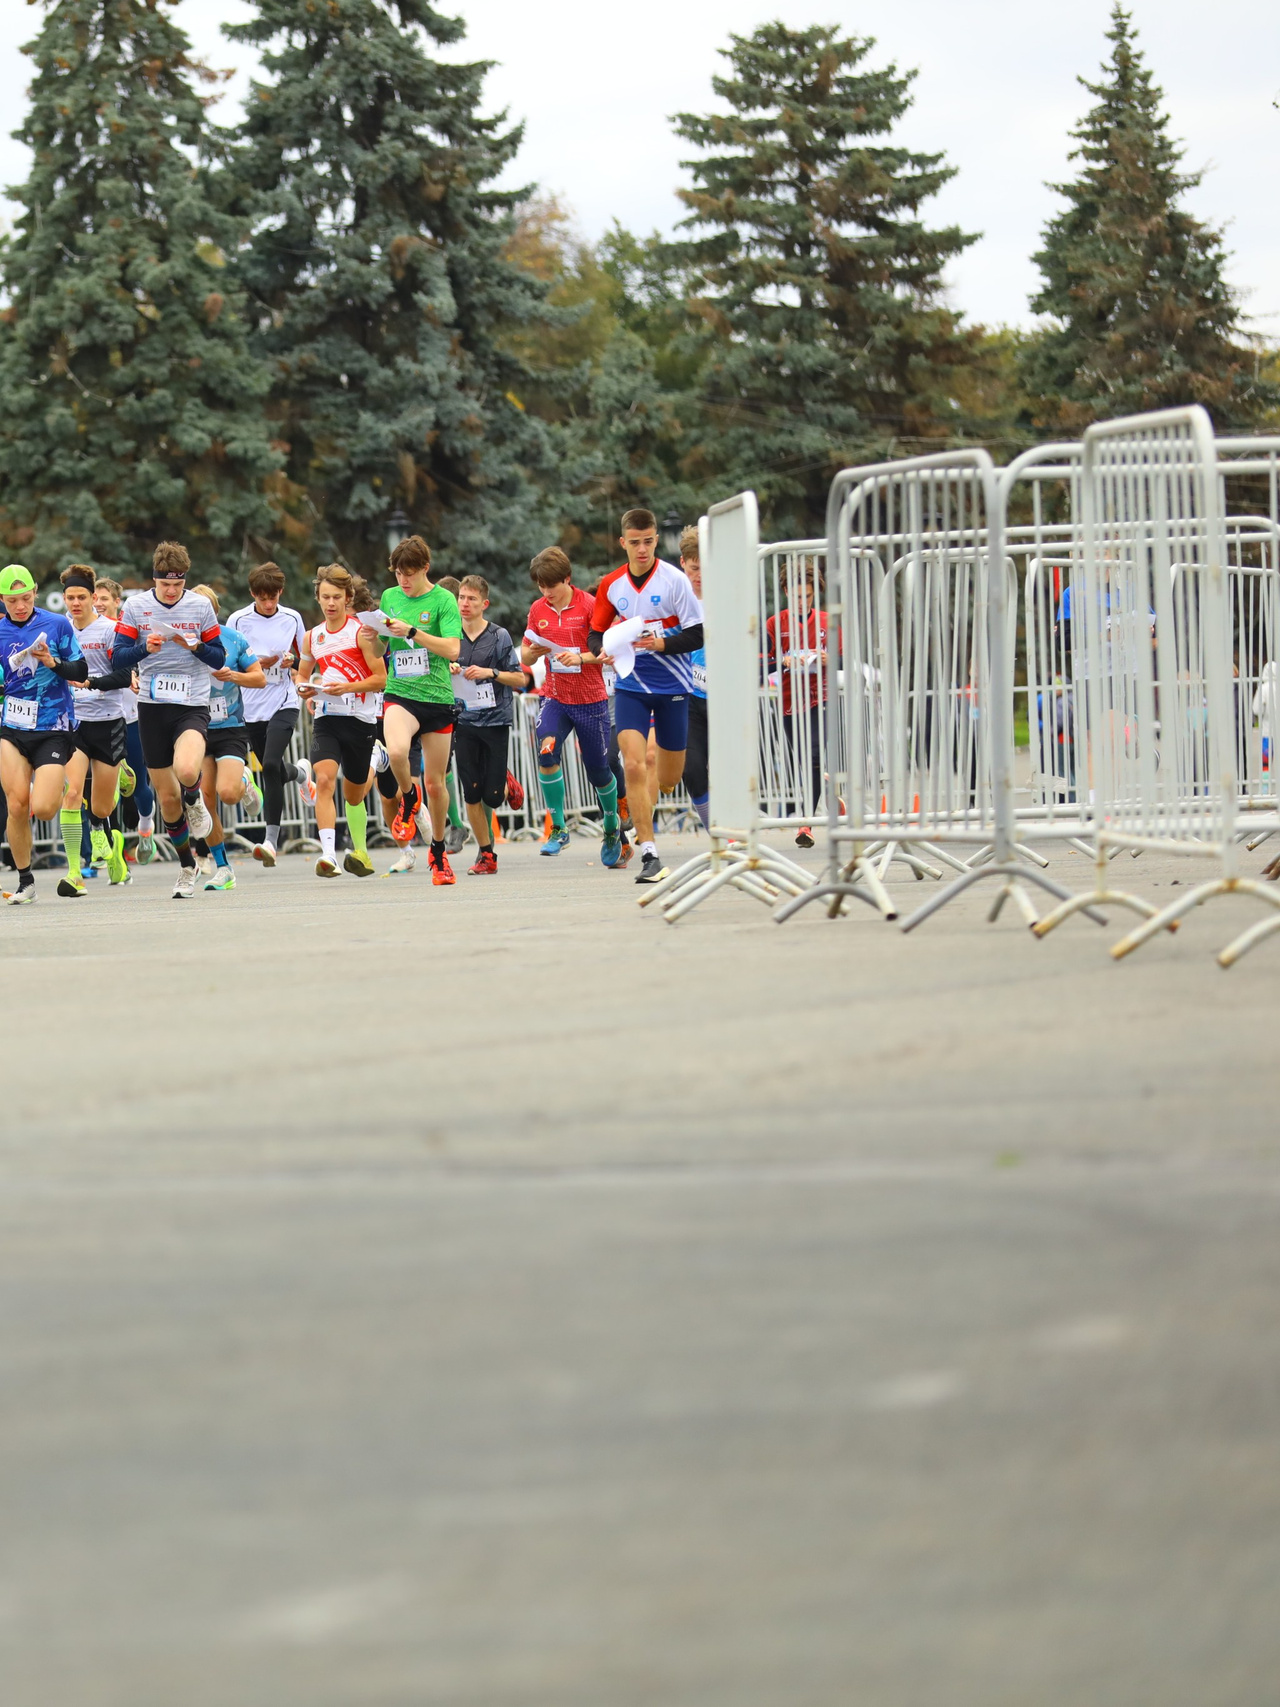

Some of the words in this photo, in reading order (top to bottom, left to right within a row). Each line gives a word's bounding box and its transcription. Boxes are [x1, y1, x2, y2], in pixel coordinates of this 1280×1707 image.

[171, 622, 201, 630] WEST
[396, 655, 422, 667] 207.1
[344, 666, 358, 679] and
[693, 670, 707, 683] 204
[157, 680, 186, 692] 210.1
[477, 690, 489, 700] 2.1
[7, 702, 31, 716] 219.1
